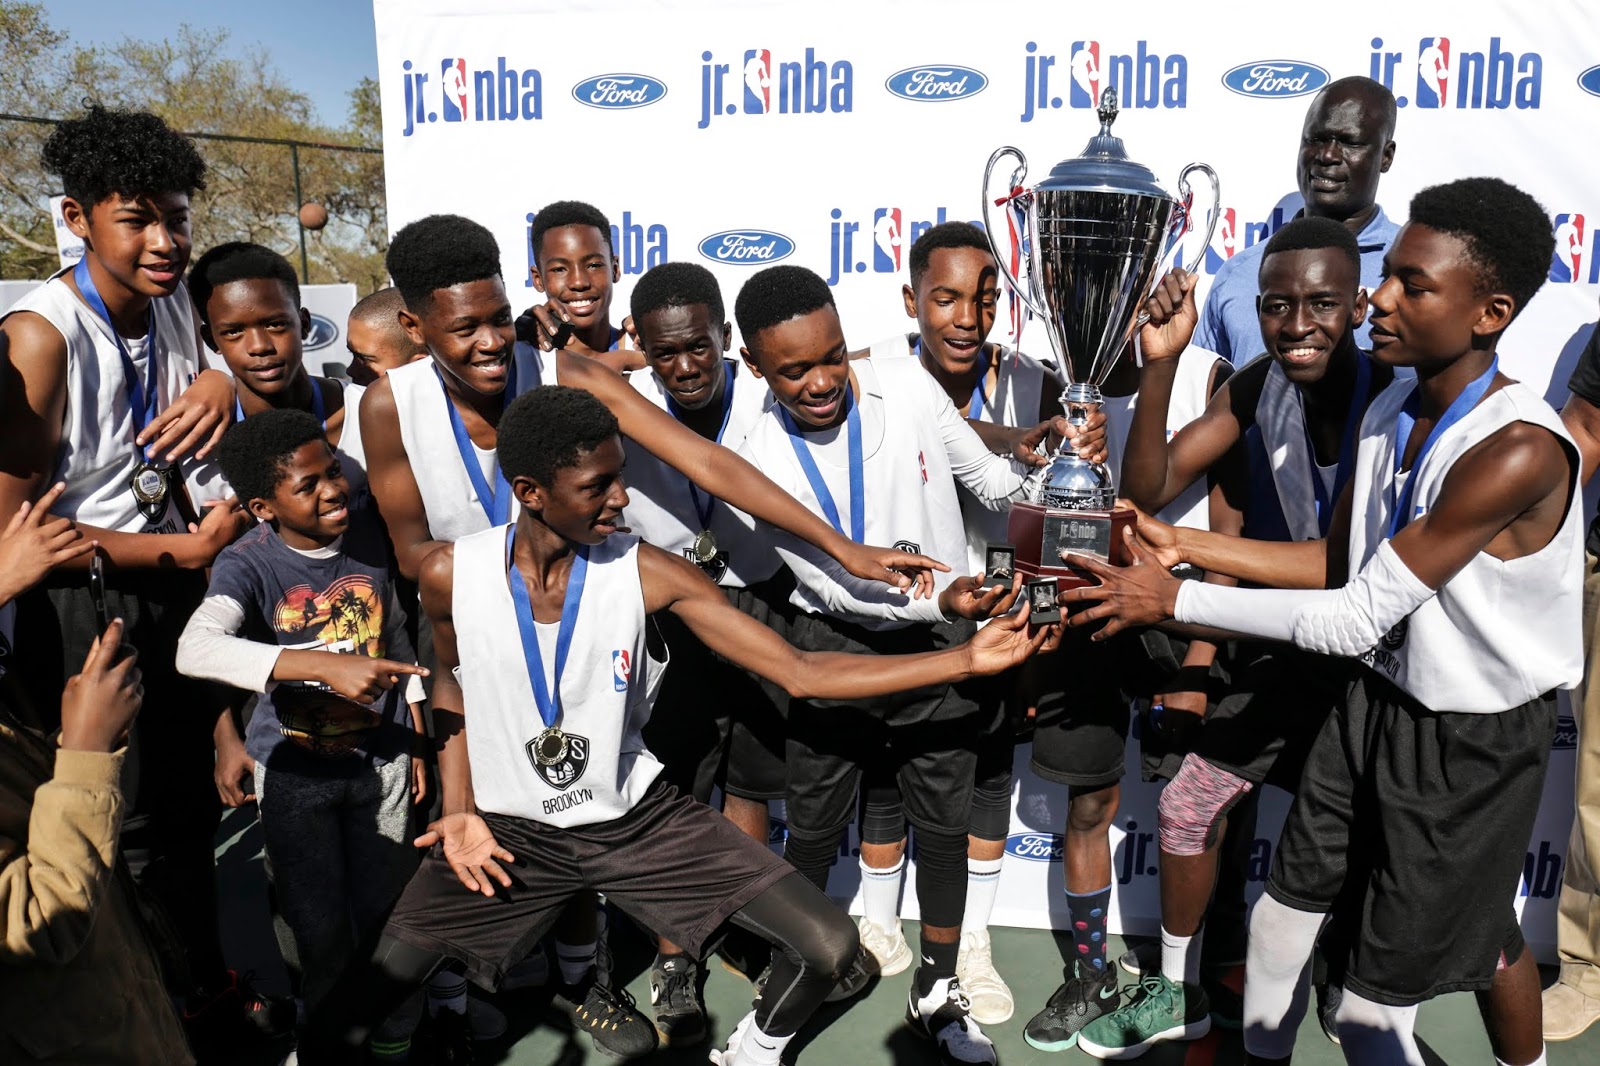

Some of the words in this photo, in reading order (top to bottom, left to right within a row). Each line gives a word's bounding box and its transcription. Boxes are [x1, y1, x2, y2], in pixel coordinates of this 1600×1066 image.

[590, 78, 648, 103] Ford
[698, 50, 737, 129] jr.
[779, 47, 853, 114] nba
[905, 70, 968, 96] Ford
[1021, 41, 1063, 122] jr.
[1109, 40, 1188, 109] nba
[1243, 65, 1309, 92] Ford
[1456, 37, 1543, 109] nba
[403, 60, 437, 137] jr.
[474, 57, 543, 121] nba
[717, 234, 776, 259] Ford
[827, 208, 867, 287] jr.
[1078, 522, 1097, 539] nba
[542, 788, 593, 815] BROOKLYN
[1118, 820, 1158, 885] jr.
